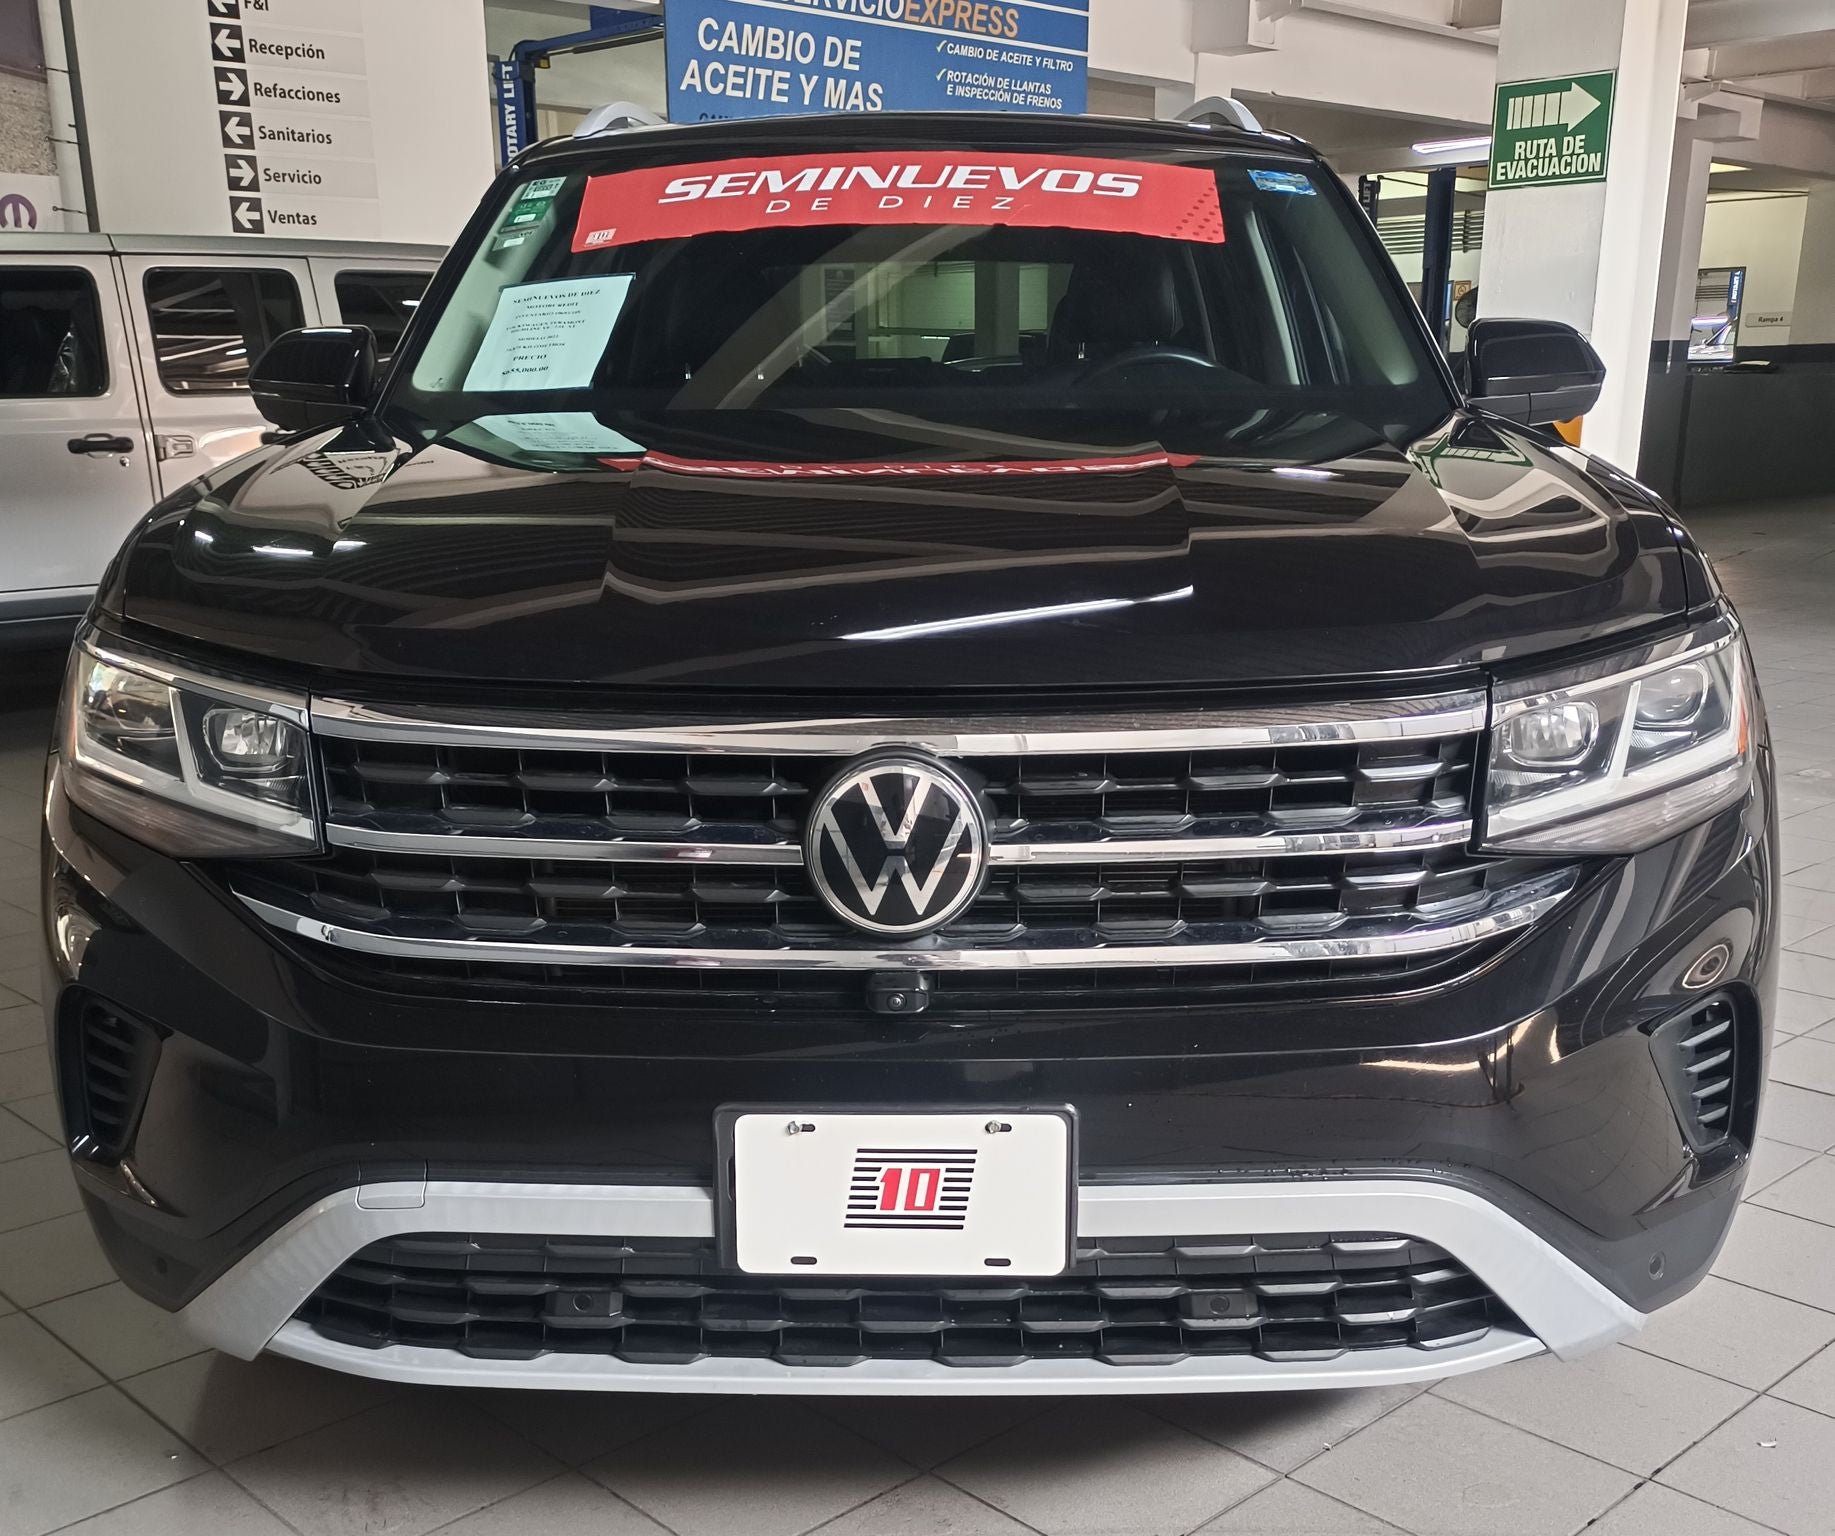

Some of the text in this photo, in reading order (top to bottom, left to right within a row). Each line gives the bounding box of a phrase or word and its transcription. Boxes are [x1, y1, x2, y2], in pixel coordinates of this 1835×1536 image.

[248, 38, 325, 60] Recepción
[697, 17, 862, 71] CAMBIO DE
[946, 43, 1073, 72] CAMBIO DE ACEITE Y FILTRO
[254, 82, 341, 104] Refacciones
[680, 59, 883, 111] ACEITE Y MAS
[946, 70, 1051, 94] ROTACIÓN DE LLANTAS
[947, 84, 1062, 110] E INSPECCIÓN DE FRENOS
[258, 125, 333, 145] Sanitarios
[504, 104, 519, 163] OTARY
[1514, 134, 1586, 160] RUTA DE
[263, 168, 322, 185] Servicio
[1496, 152, 1601, 181] EVACUACION
[658, 165, 1142, 204] SEMINUEVOS
[267, 209, 317, 226] Ventas
[765, 195, 1014, 214] DE DIEZ
[880, 1167, 941, 1212] 10
